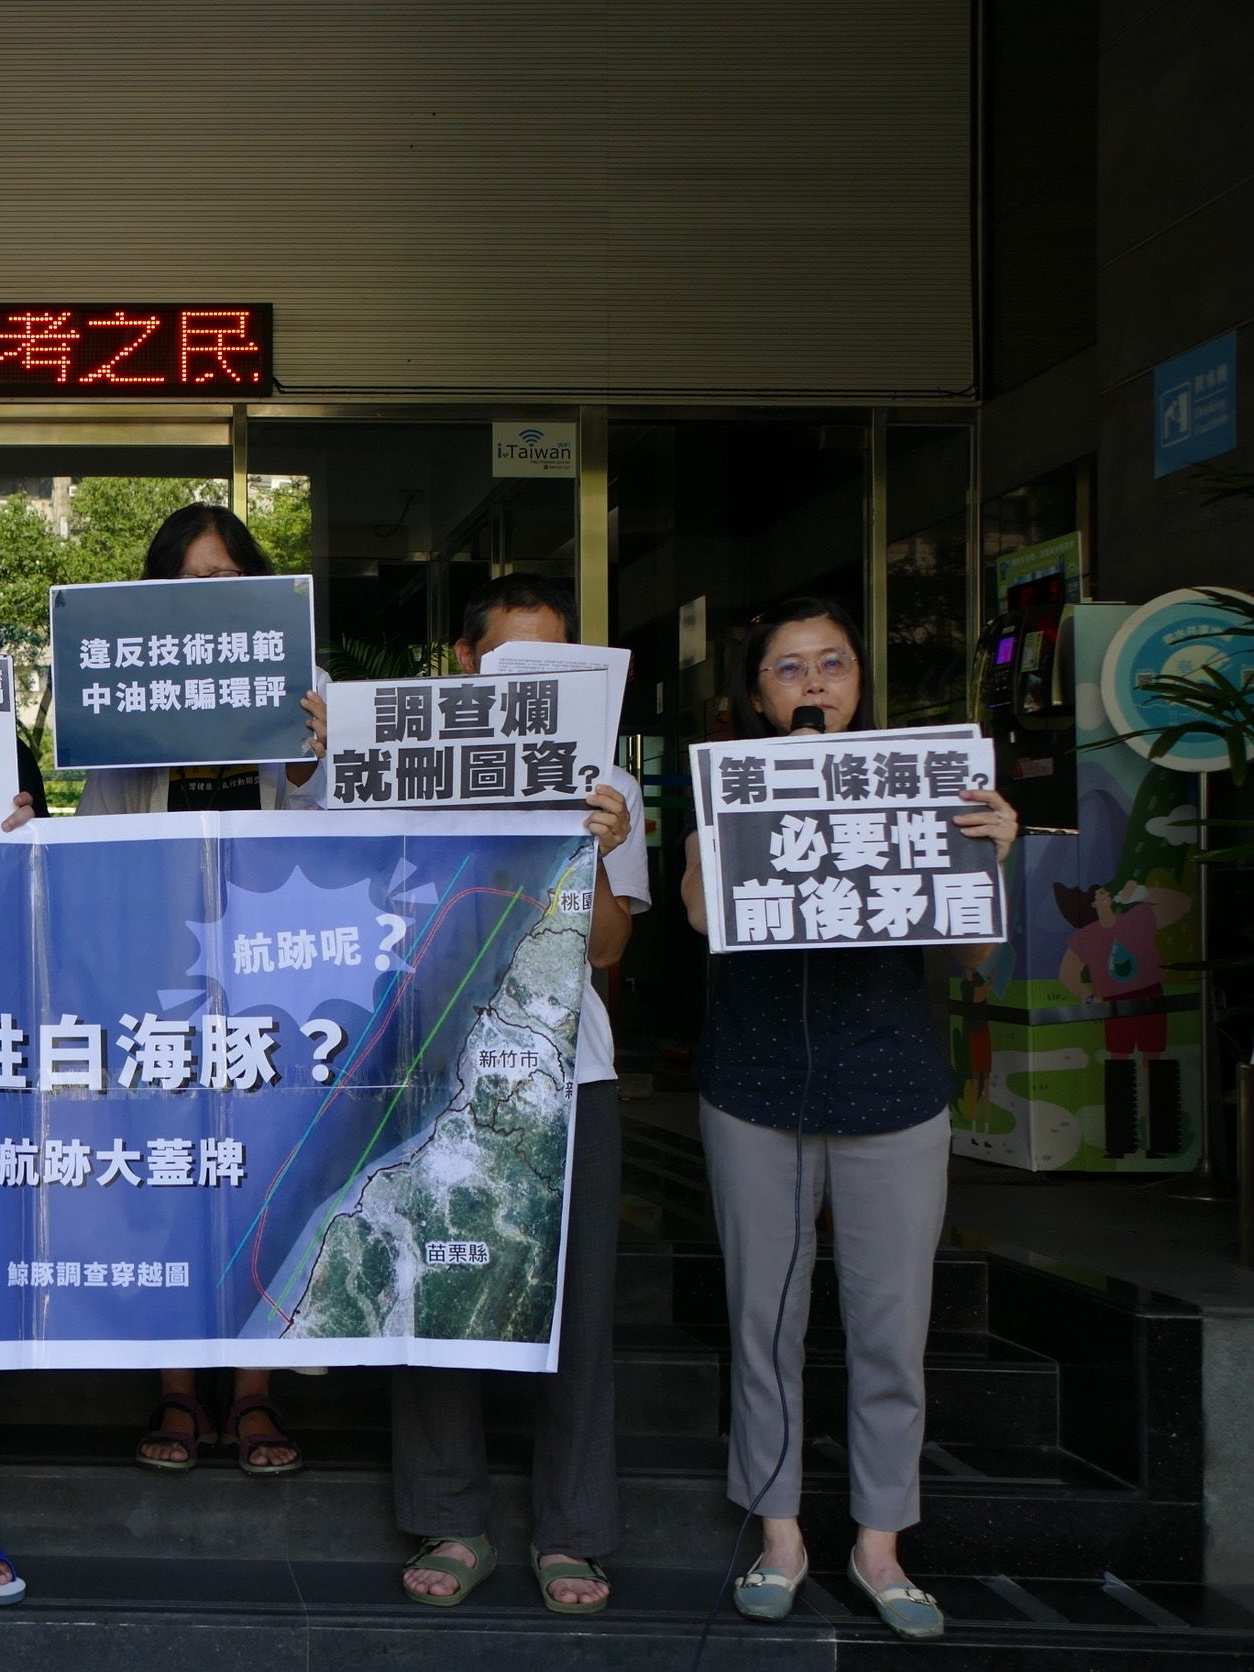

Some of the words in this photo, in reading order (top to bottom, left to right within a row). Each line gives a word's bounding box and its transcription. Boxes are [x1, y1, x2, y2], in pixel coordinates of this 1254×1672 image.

[79, 630, 285, 670] 違反技術規範
[82, 675, 287, 714] 中油欺騙環評
[374, 679, 559, 743] 調查爛
[769, 810, 951, 873] 必要性
[732, 871, 994, 943] 前後矛盾
[233, 913, 406, 975] 航跡呢？
[478, 1049, 539, 1069] 新竹市
[427, 1243, 489, 1264] 苗栗縣
[7, 1260, 190, 1288] 鯨豚調查穿越圖
